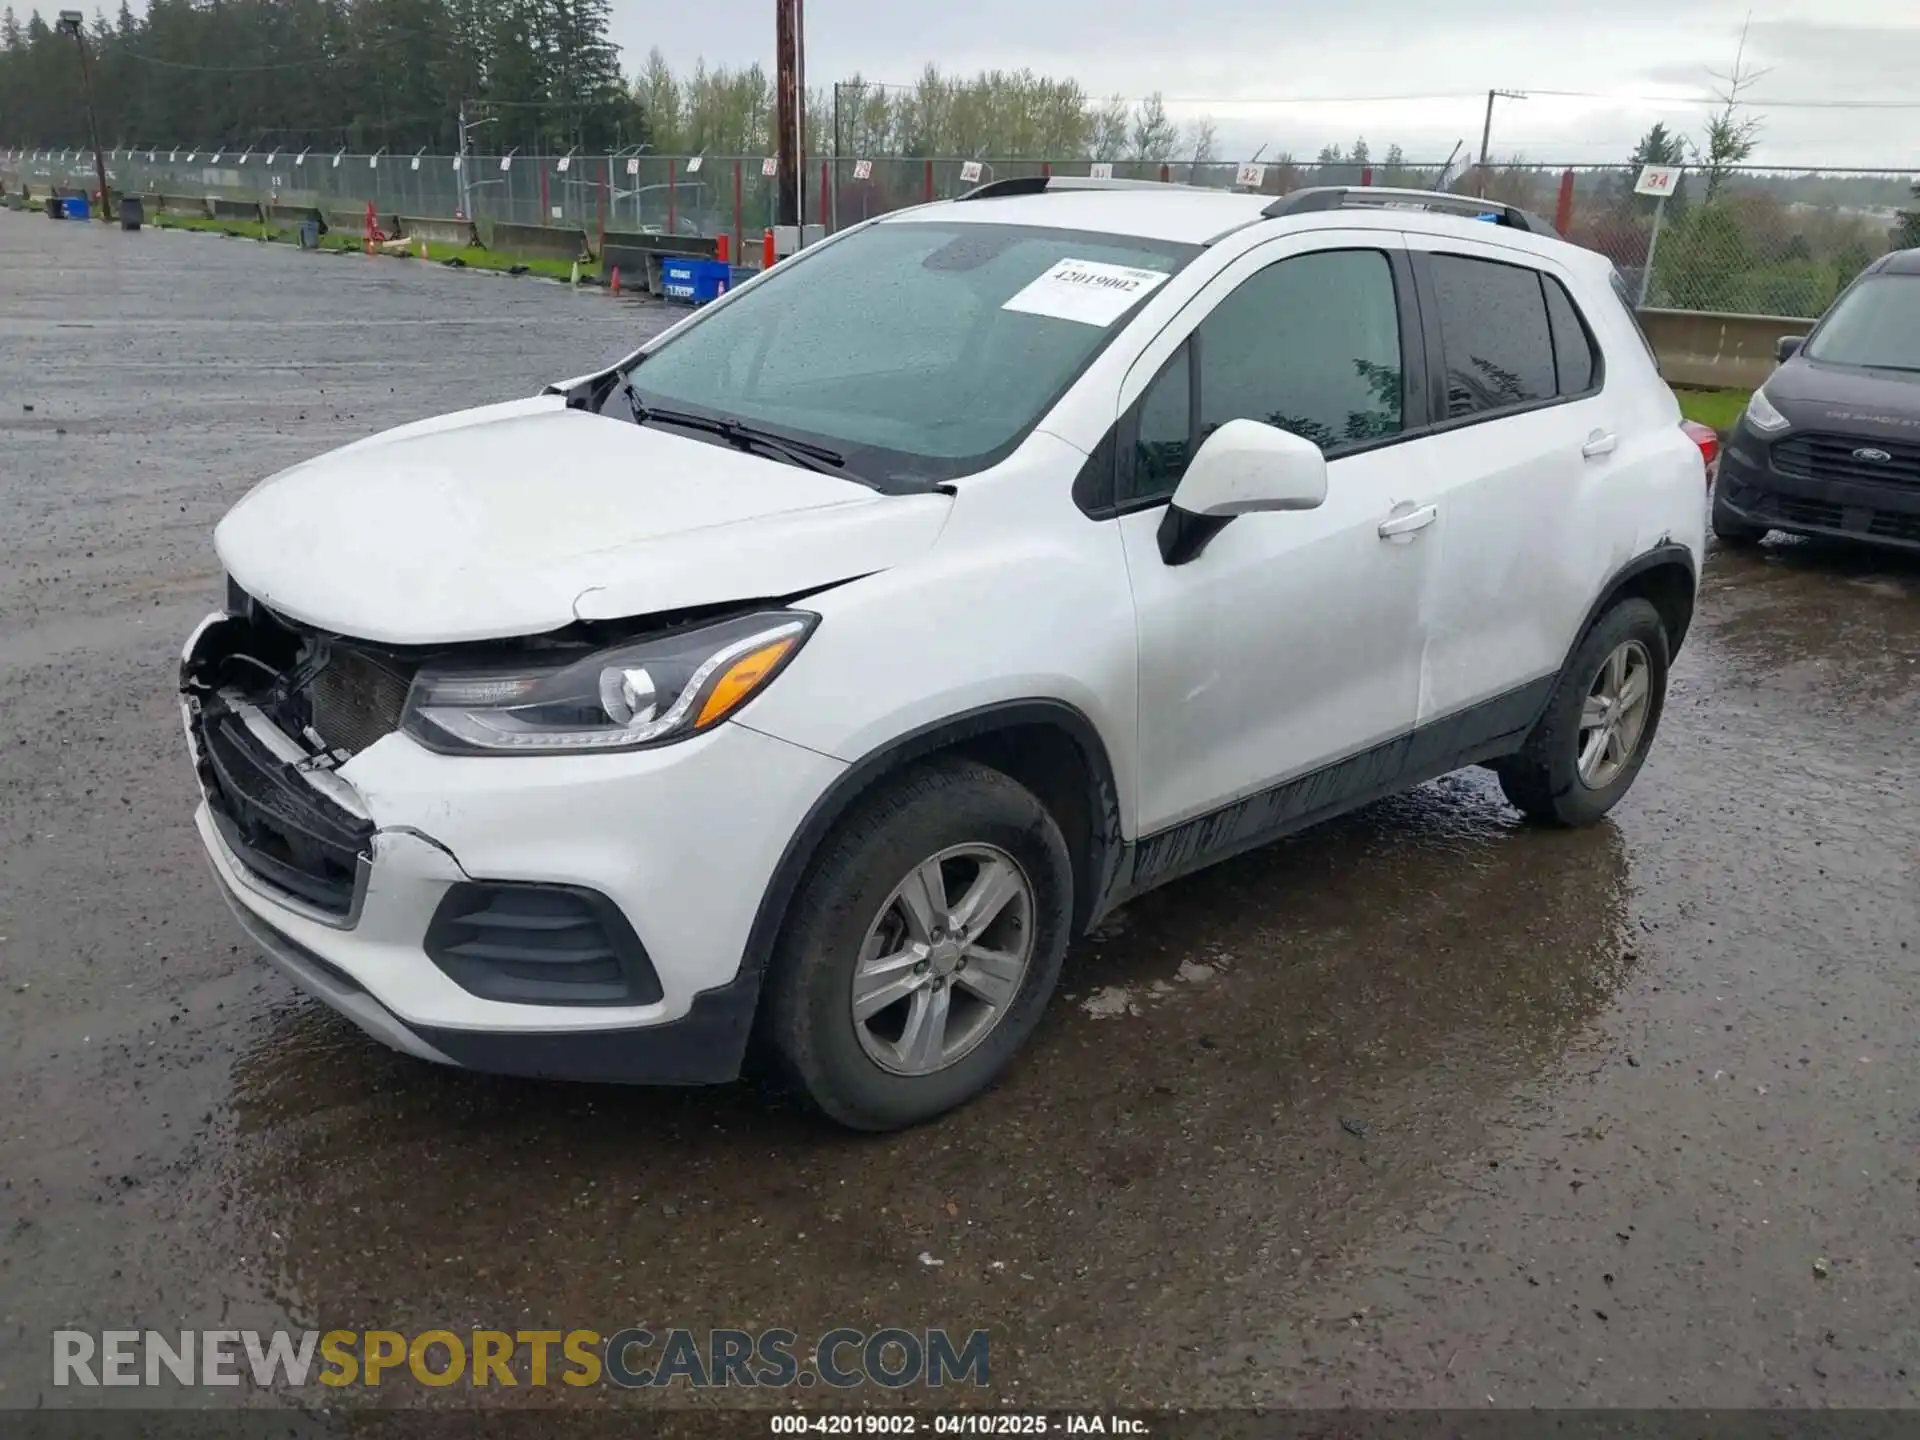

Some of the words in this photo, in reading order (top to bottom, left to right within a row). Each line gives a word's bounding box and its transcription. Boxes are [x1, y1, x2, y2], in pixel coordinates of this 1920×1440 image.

[1242, 167, 1259, 182] 32
[1647, 171, 1669, 188] 34
[1052, 269, 1141, 292] 42019002
